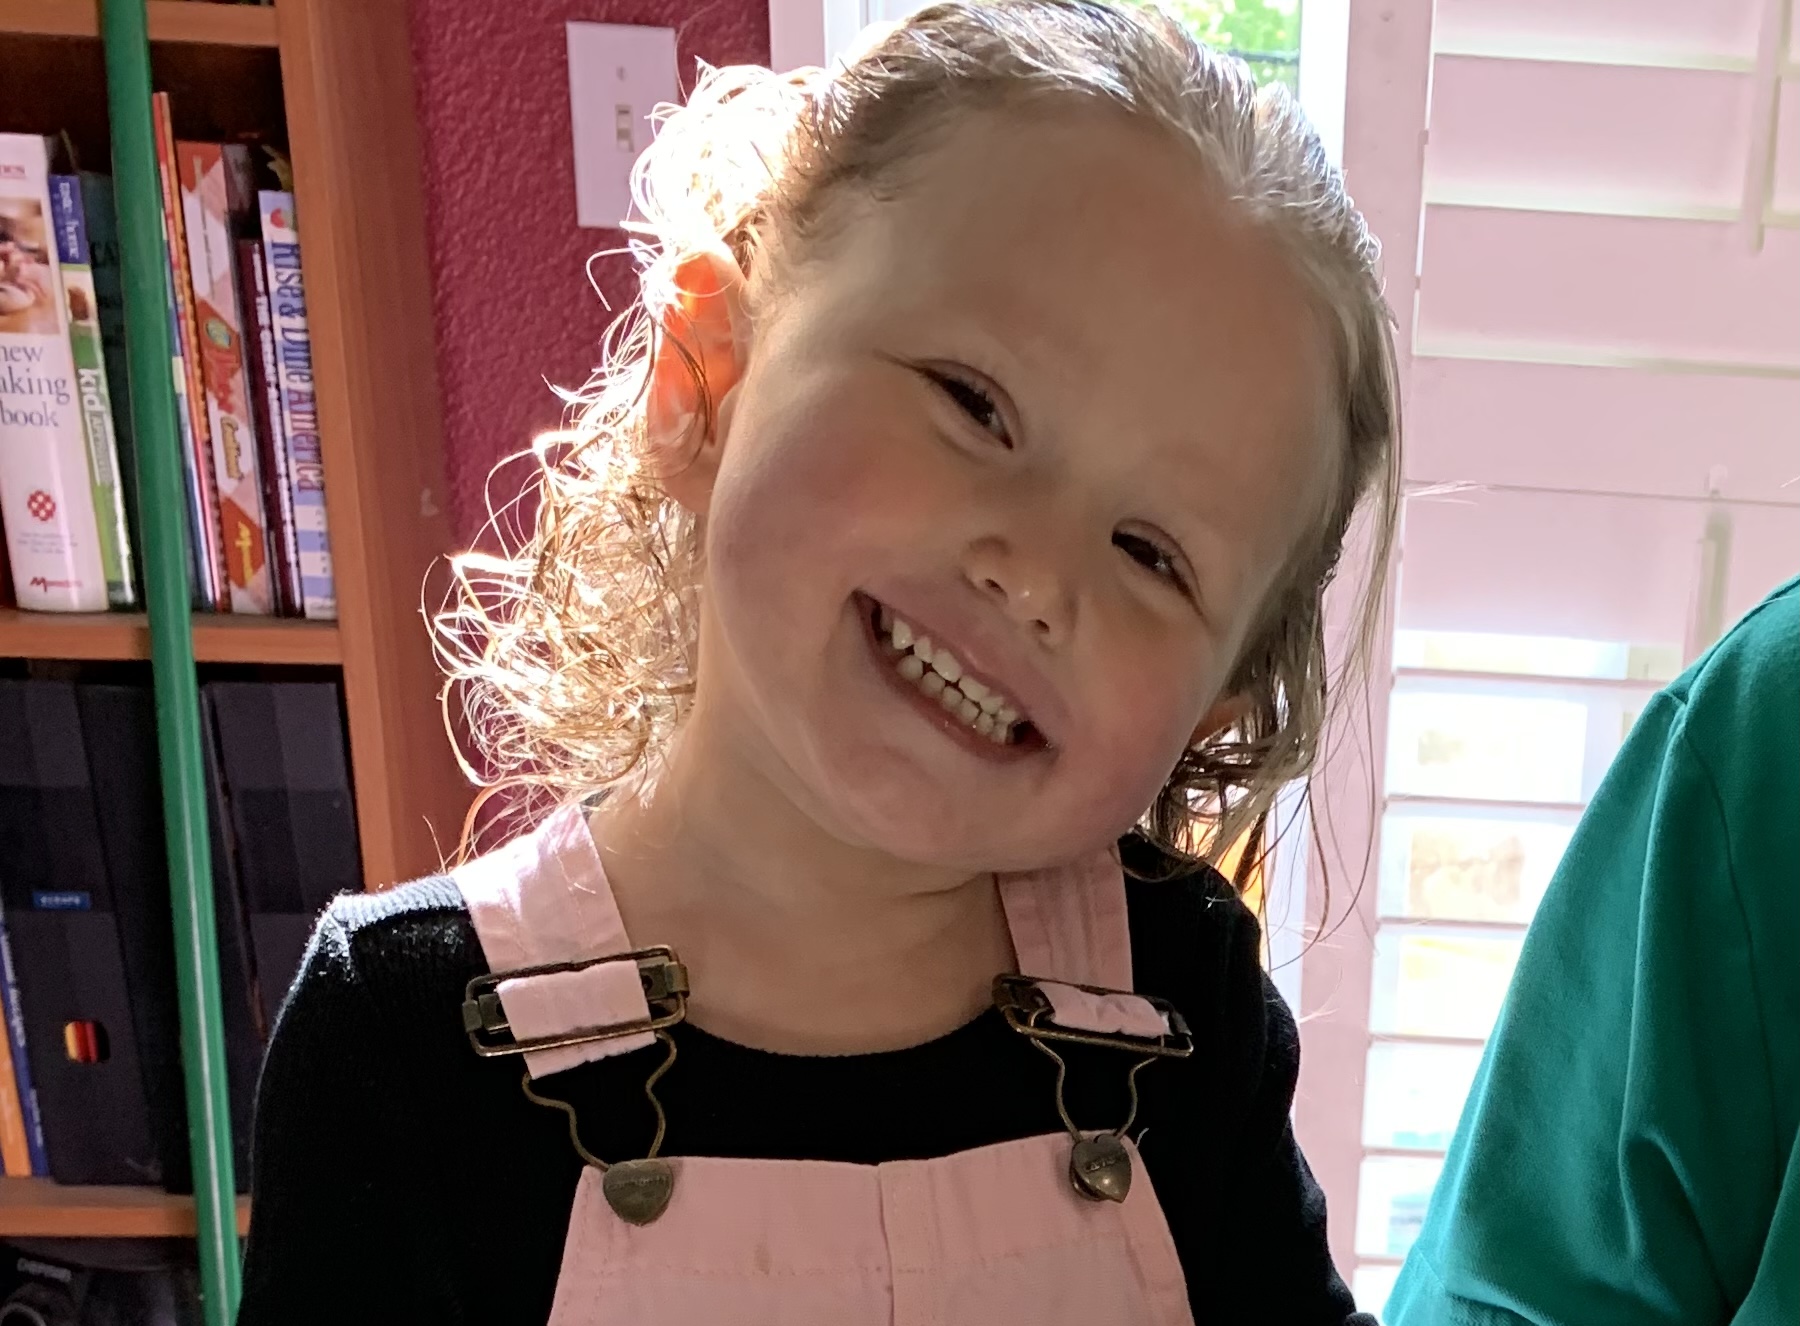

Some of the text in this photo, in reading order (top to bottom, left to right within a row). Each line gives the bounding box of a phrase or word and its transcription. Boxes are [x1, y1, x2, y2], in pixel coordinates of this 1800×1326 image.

[271, 242, 305, 298] Rise
[279, 302, 308, 318] &
[281, 327, 314, 383] Dine
[0, 398, 59, 427] book
[78, 367, 106, 412] kid
[287, 388, 325, 492] America
